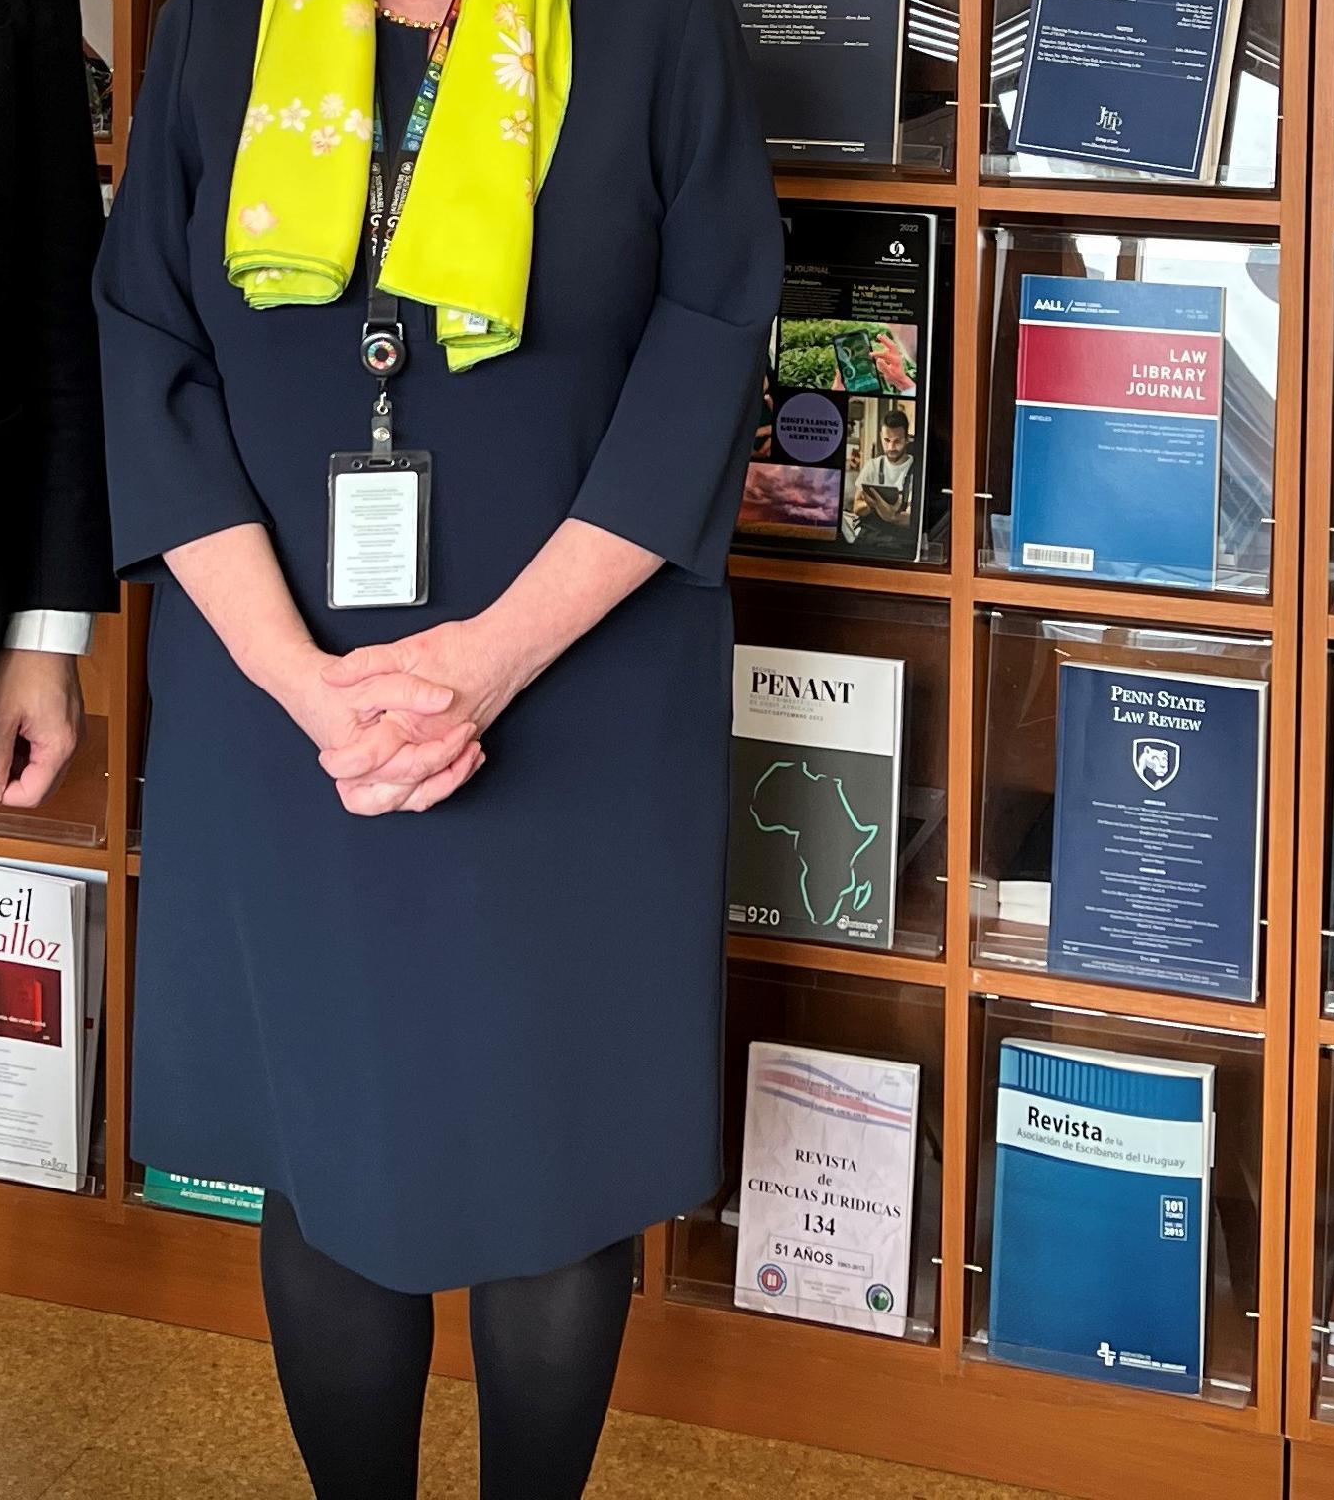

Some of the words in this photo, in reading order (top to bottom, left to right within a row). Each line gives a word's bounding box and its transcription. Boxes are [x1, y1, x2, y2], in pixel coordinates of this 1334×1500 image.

[1034, 299, 1065, 312] AALL
[1170, 348, 1207, 364] LAW
[1132, 364, 1206, 382] LIBRARY
[1126, 382, 1206, 400] JOURNAL
[751, 671, 856, 705] PENANT
[1111, 685, 1153, 705] PENN
[1157, 690, 1207, 713] STATE
[1113, 705, 1145, 725] LAW
[1148, 710, 1202, 732] REVIEW
[747, 905, 781, 927] 920
[1027, 1105, 1103, 1142] Revista
[794, 1149, 858, 1174] REVISTA
[1062, 1138, 1074, 1150] de
[1075, 1141, 1124, 1159] Escribanos
[1125, 1149, 1142, 1162] del
[1142, 1152, 1186, 1169] Uruguay
[817, 1174, 834, 1188] de
[747, 1178, 819, 1204] CIENCIAS
[820, 1191, 901, 1219] JURIDICAS
[1164, 1199, 1184, 1213] 101
[802, 1213, 837, 1238] 134
[774, 1242, 789, 1258] 51
[793, 1244, 834, 1265] AÑOS
